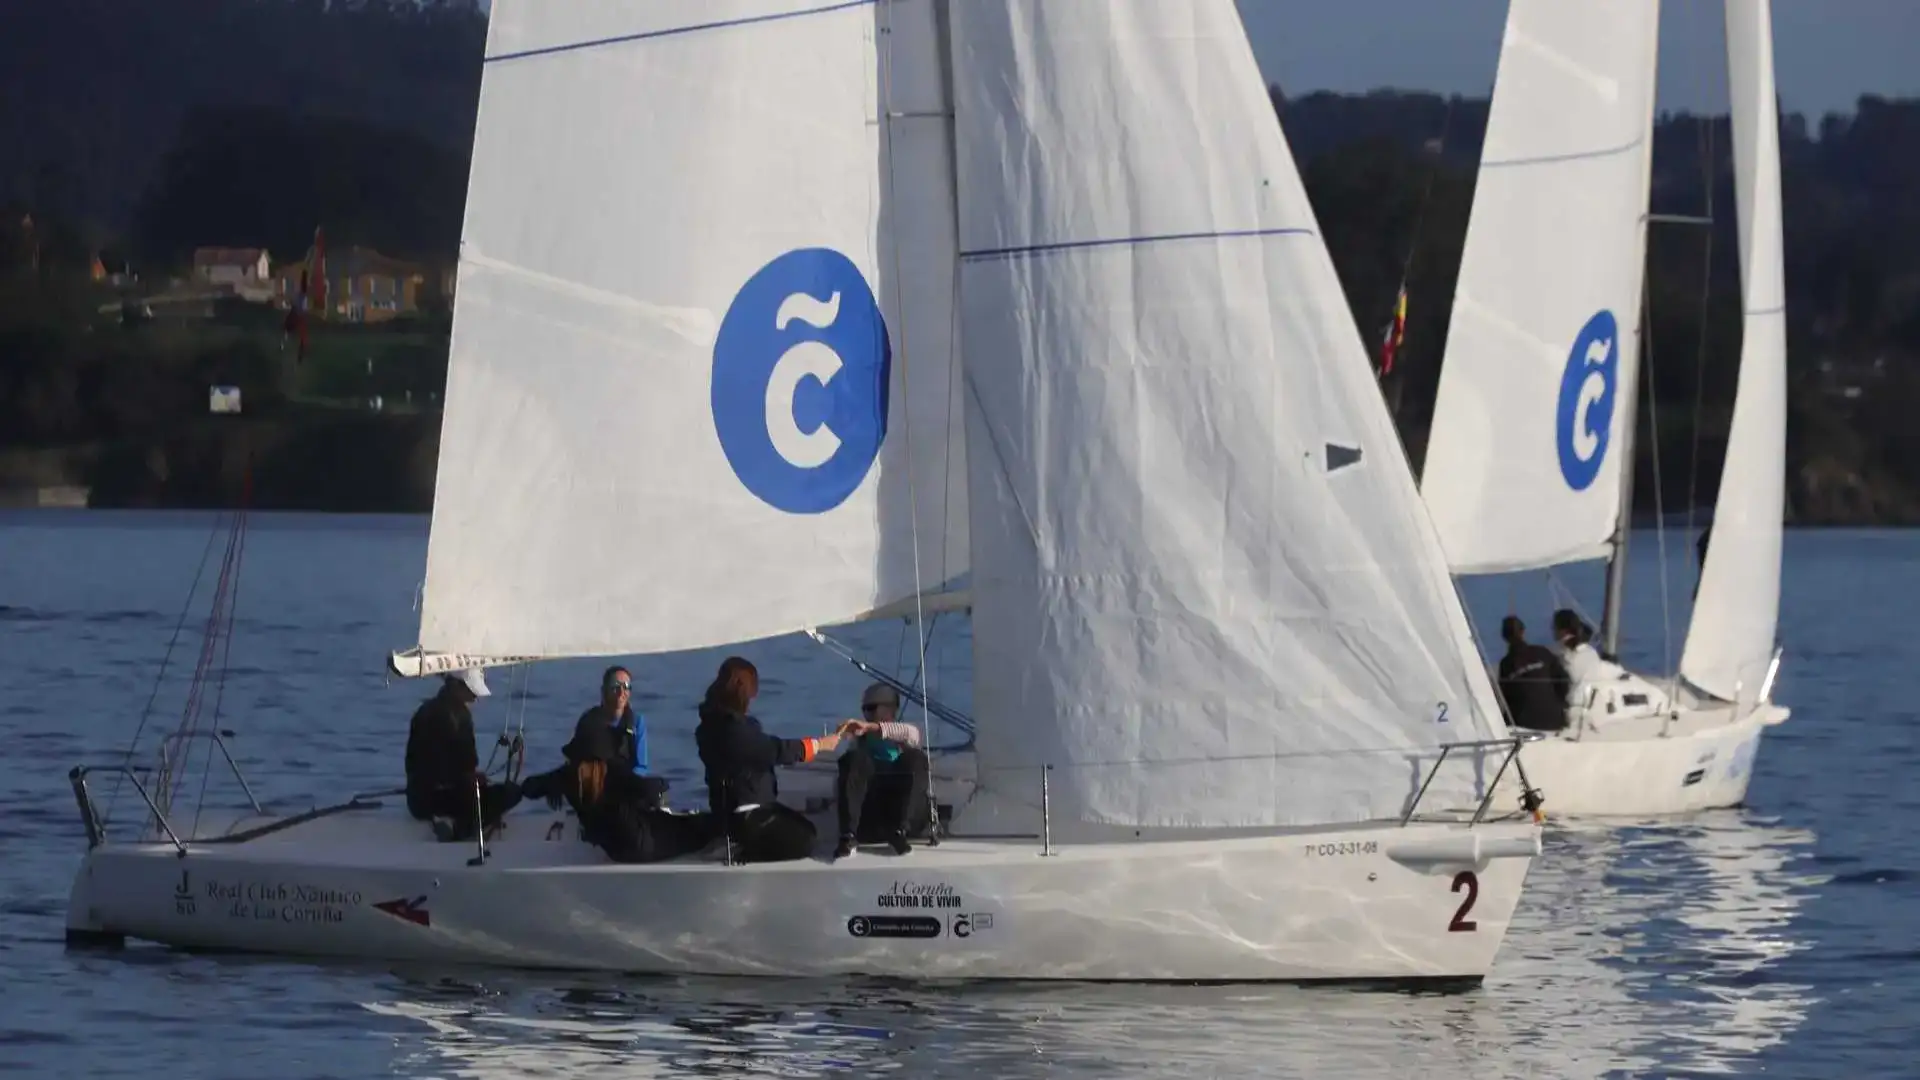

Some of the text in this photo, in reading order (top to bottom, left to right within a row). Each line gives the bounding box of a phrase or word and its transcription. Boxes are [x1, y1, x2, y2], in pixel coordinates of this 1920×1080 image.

[1437, 701, 1449, 722] 2
[176, 870, 189, 893] J
[206, 880, 243, 898] Real
[247, 880, 287, 900] Club
[902, 881, 953, 895] Coruña
[229, 899, 249, 917] de
[281, 904, 343, 923] Coruña
[878, 895, 961, 908] CULTURA DE VIVIR
[1448, 870, 1478, 932] 2
